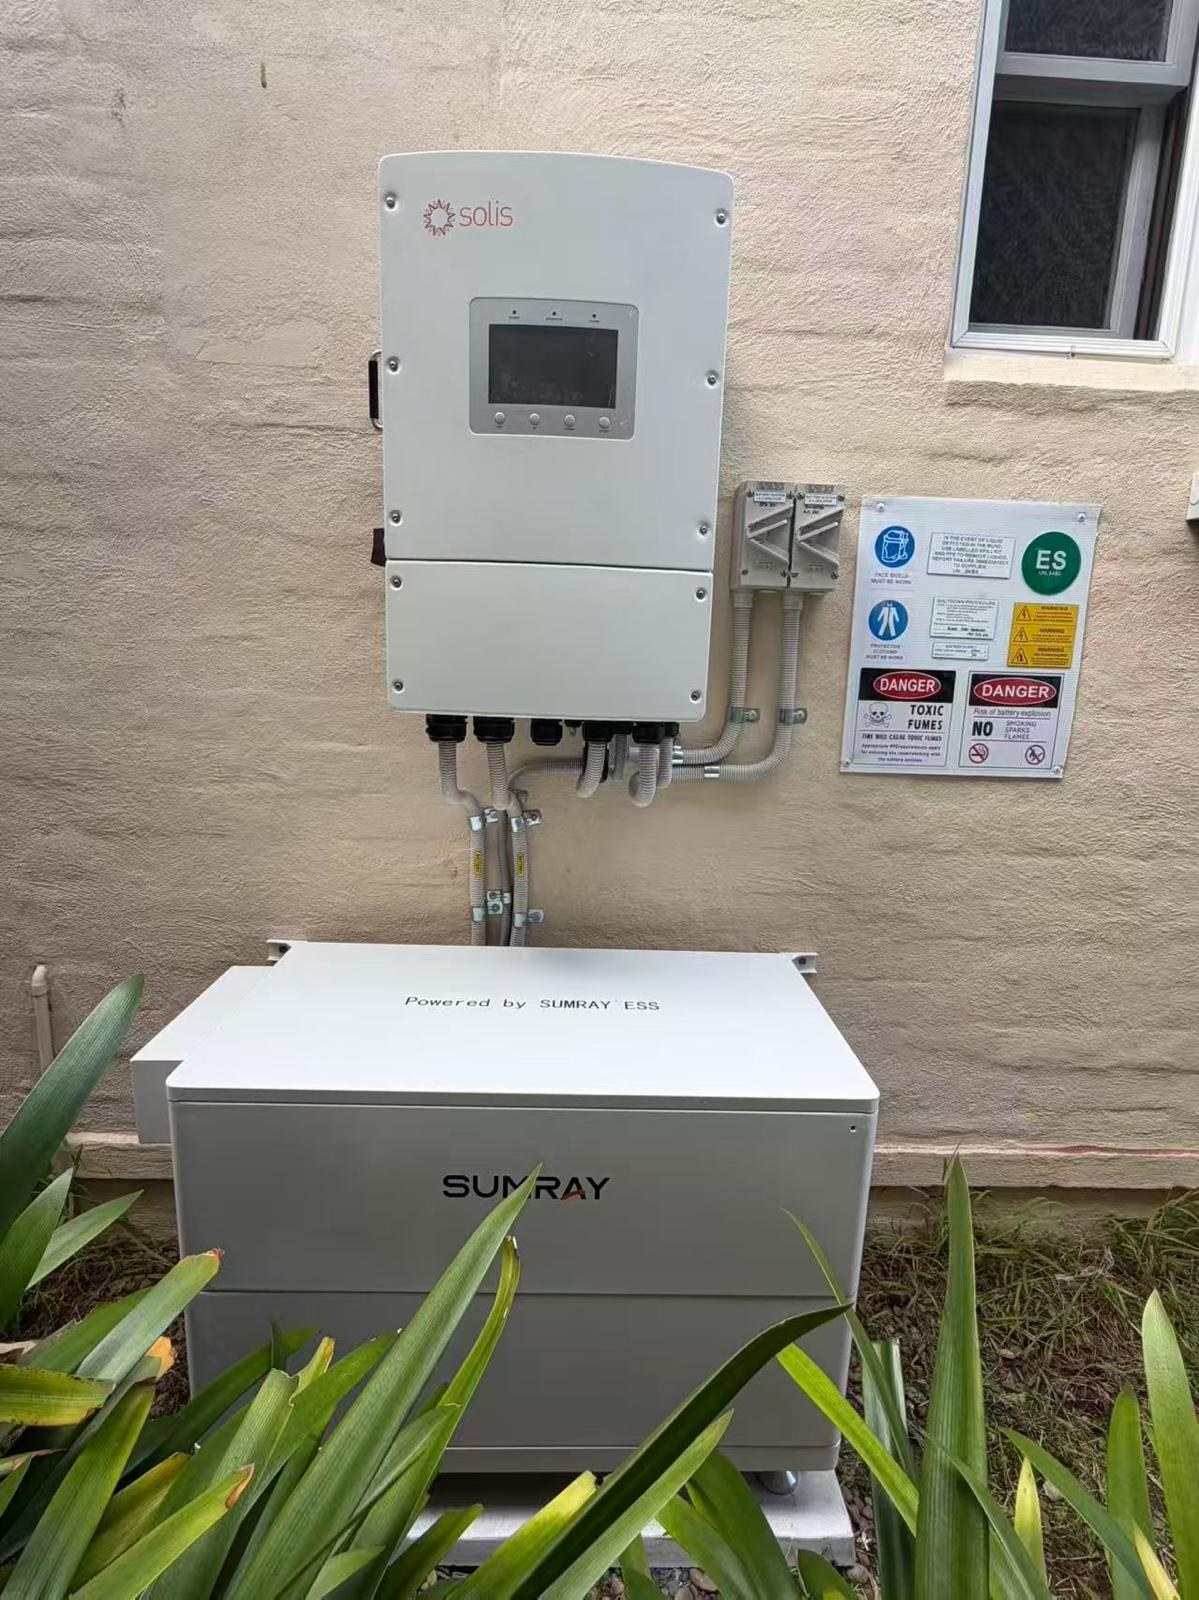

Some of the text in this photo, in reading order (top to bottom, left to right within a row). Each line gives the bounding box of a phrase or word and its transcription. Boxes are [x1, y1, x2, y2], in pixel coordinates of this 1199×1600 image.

[459, 200, 513, 226] solis
[1036, 550, 1067, 570] ES
[880, 679, 936, 692] DANGER
[982, 685, 1049, 698] DANGER
[910, 705, 944, 716] TOXIC
[997, 709, 1019, 717] battery
[908, 719, 942, 730] FUMES
[972, 721, 993, 736] NO
[404, 996, 660, 1011] Powered by SUMRAY ESS
